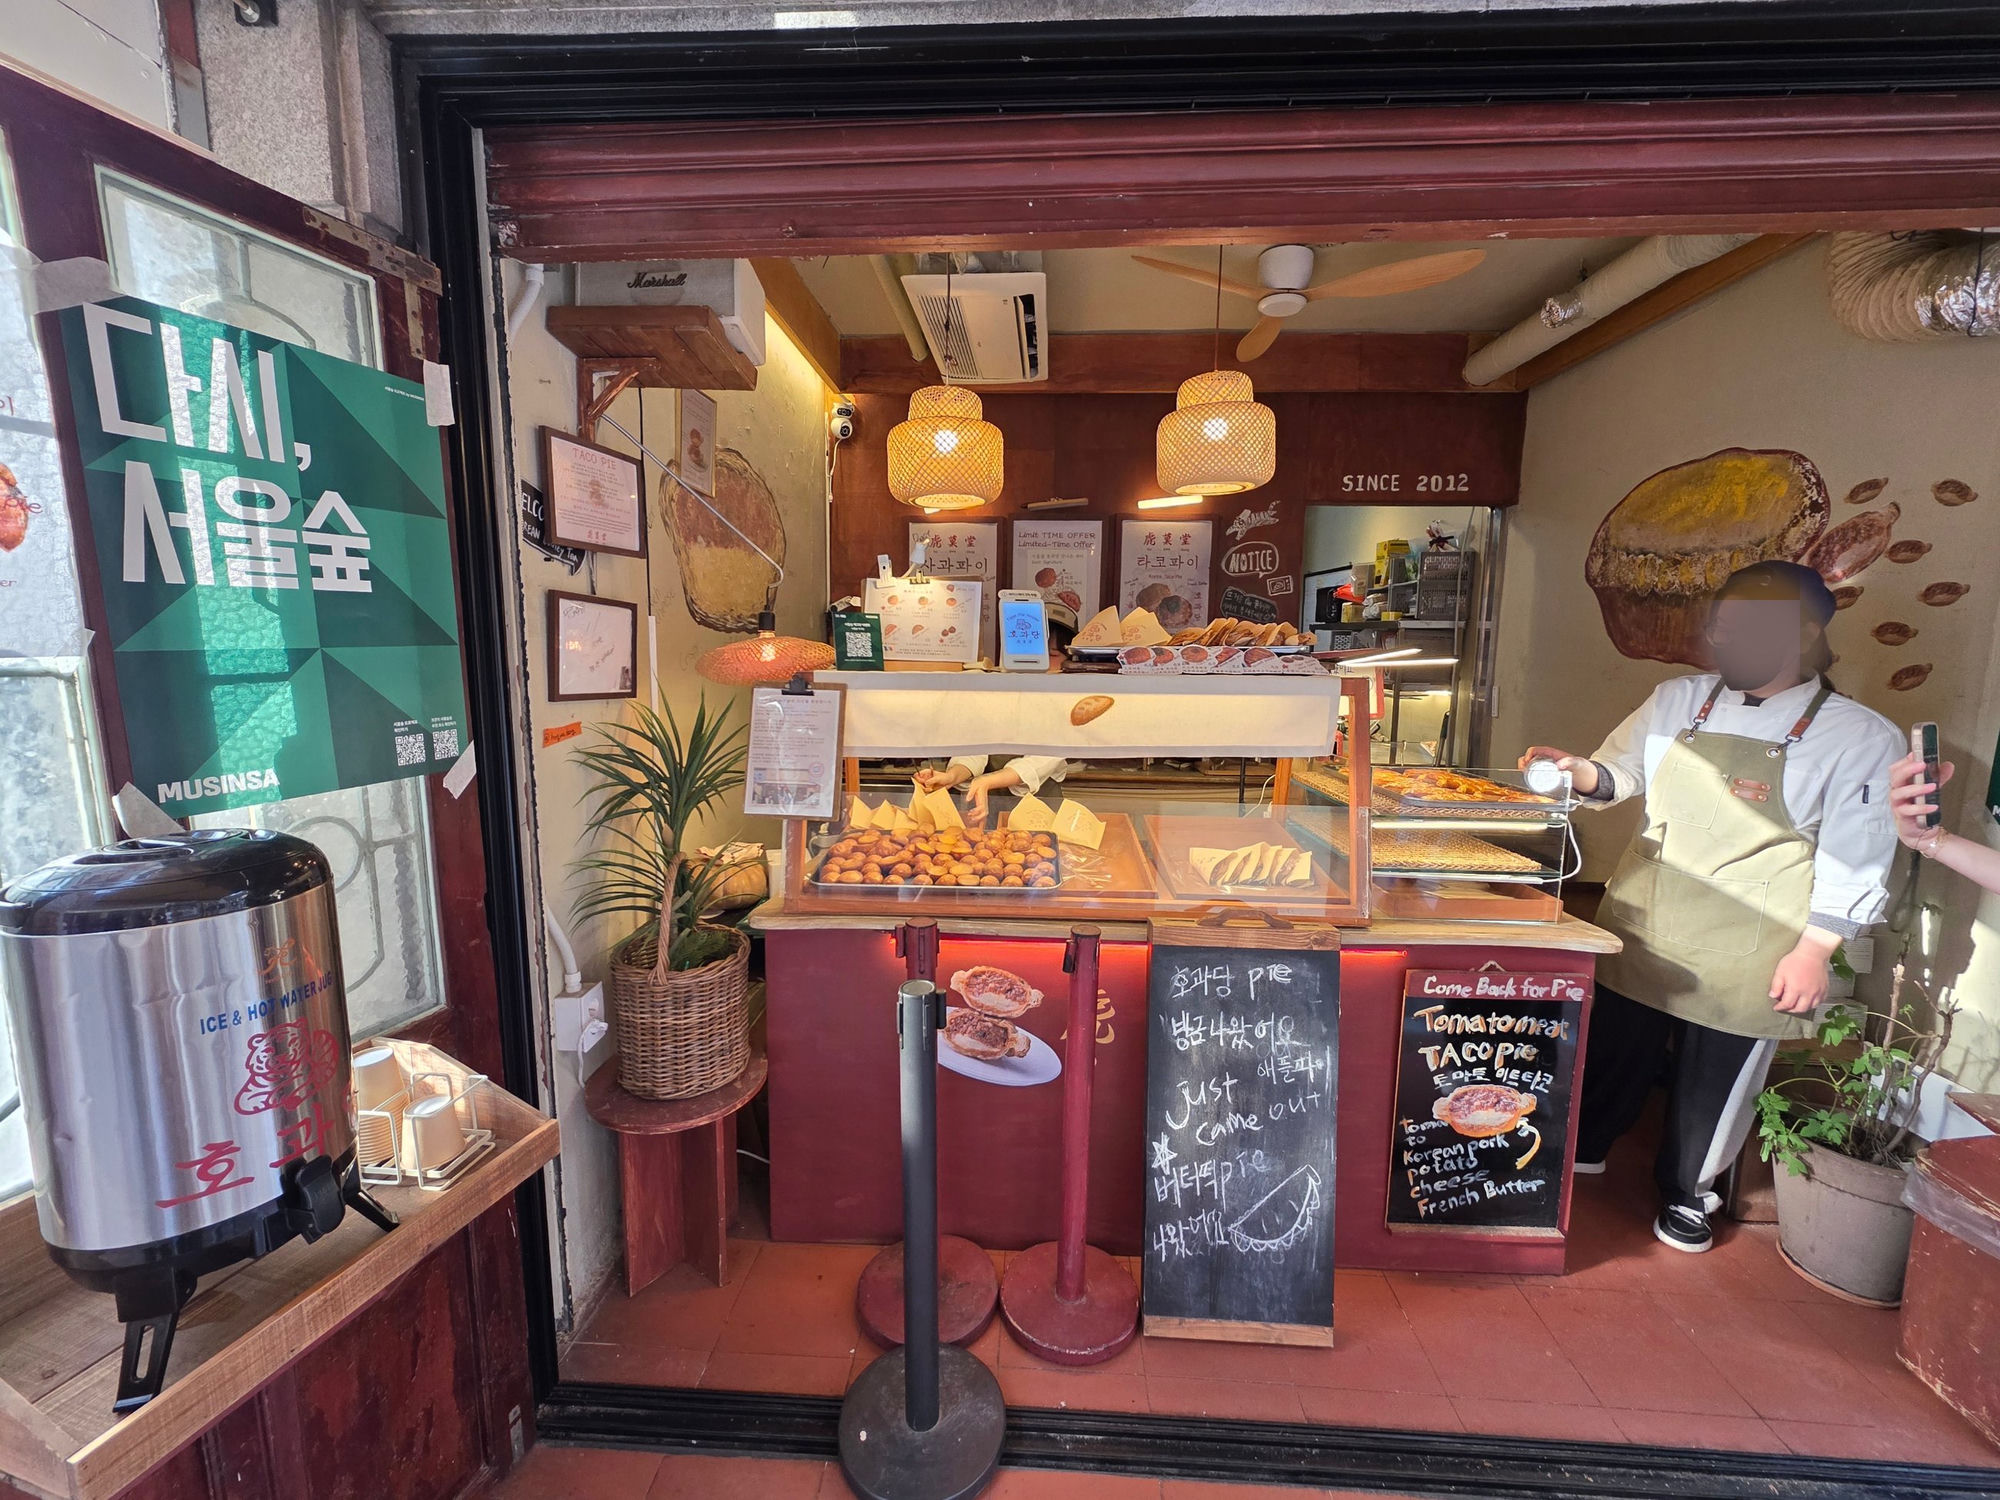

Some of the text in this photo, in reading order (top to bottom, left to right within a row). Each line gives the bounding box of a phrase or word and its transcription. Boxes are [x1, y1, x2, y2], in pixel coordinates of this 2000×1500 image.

[627, 272, 688, 288] Marshall
[82, 302, 312, 472] 다시,
[572, 447, 617, 471] TACO PIE
[1341, 473, 1469, 492] SINCE 2012
[122, 459, 373, 593] 서울숲
[1018, 531, 1038, 539] Limit
[1066, 531, 1096, 540] OFFER
[920, 557, 988, 573] 사과파이
[1137, 554, 1199, 570] 타코파이
[1228, 549, 1273, 573] NOTICE
[157, 766, 280, 804] MUSINSA
[1171, 965, 1235, 999] 호과당
[1423, 975, 1585, 1002] Come Back for Pie
[200, 971, 333, 1035] ICE & HOT WATER JUG
[1432, 1066, 1491, 1089] 토마토
[1269, 1091, 1321, 1120] out
[1406, 1135, 1427, 1147] to
[1417, 1178, 1546, 1220] French Butter
